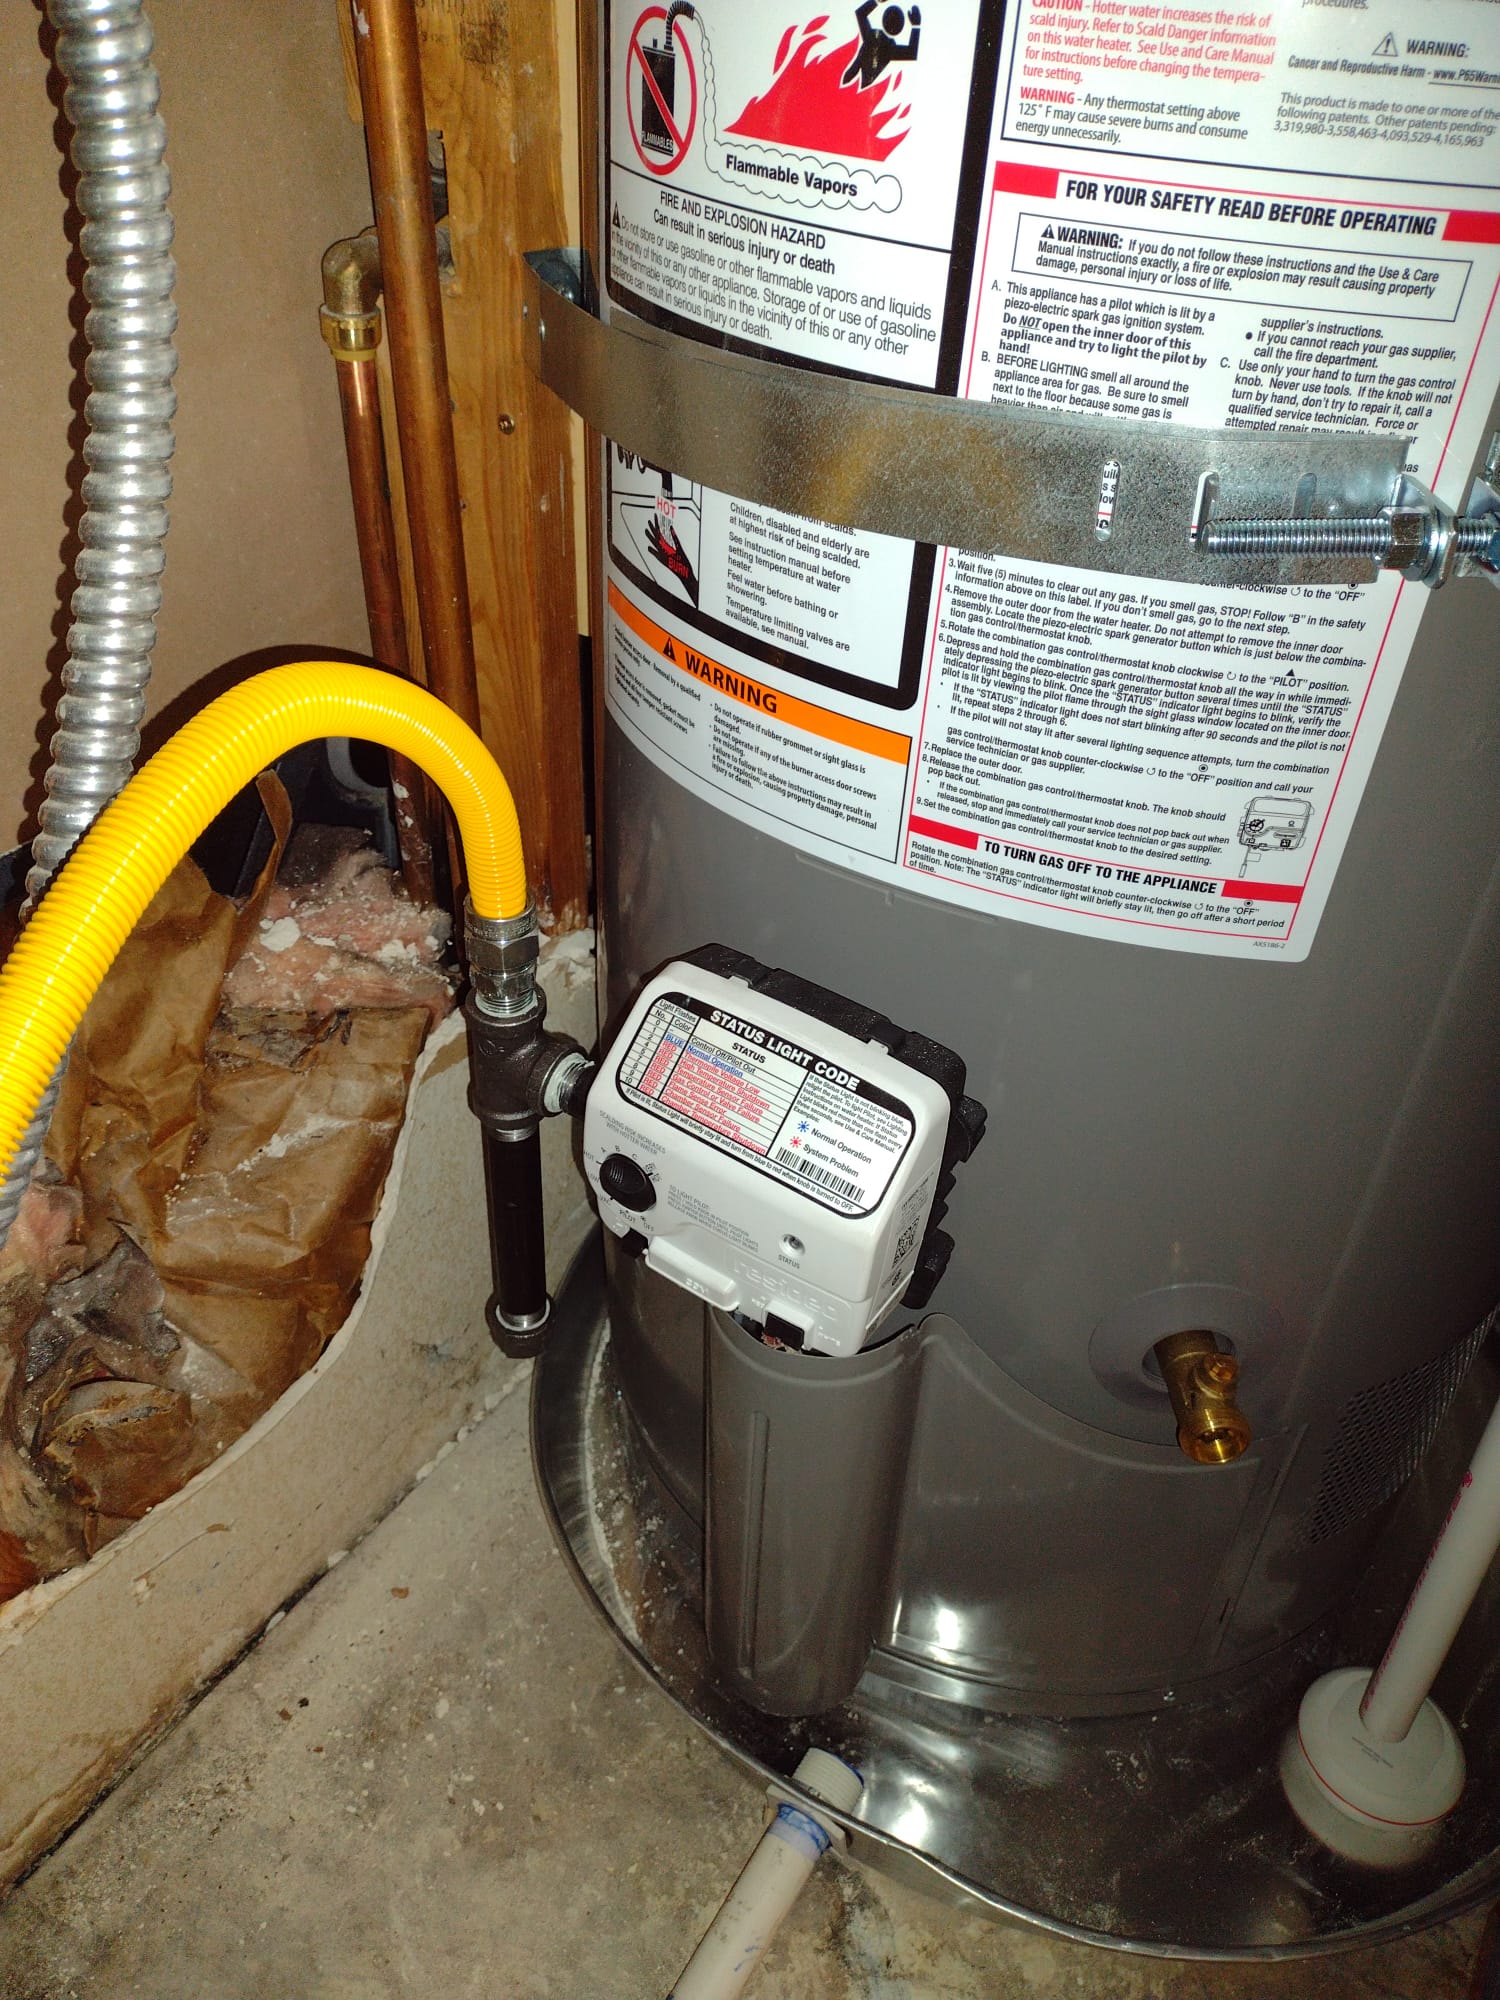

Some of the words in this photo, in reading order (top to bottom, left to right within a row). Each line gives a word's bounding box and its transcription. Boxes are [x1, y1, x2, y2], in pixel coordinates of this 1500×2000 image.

[1406, 39, 1470, 58] WARNING:
[1019, 86, 1075, 103] WARNING
[1083, 92, 1105, 110] Any
[1105, 95, 1166, 113] thermostat
[1166, 102, 1205, 120] setting
[1205, 105, 1241, 121] above
[1015, 120, 1050, 136] energy
[1051, 123, 1120, 145] unnecessarily.
[726, 154, 799, 184] Flammable
[804, 173, 857, 196] Vapors
[1065, 180, 1098, 200] FOR
[1102, 184, 1147, 206] YOUR
[1149, 190, 1214, 214] SAFETY
[1217, 198, 1265, 220] READ
[1267, 203, 1336, 227] BEFORE
[1338, 210, 1438, 235] OPERATING
[660, 191, 680, 210] FIRE
[680, 198, 702, 217] AND
[703, 205, 767, 235] EXPLOSION
[770, 223, 825, 249] HAZARD
[652, 207, 669, 226] Can
[670, 217, 694, 235] result
[696, 223, 705, 238] in
[707, 229, 745, 250] serious
[747, 238, 780, 263] injury
[783, 251, 796, 264] or
[799, 252, 835, 274] death
[1056, 226, 1123, 249] WARNING:
[1128, 238, 1136, 251] If
[1137, 242, 1158, 254] you
[1160, 243, 1174, 255] do
[1177, 246, 1195, 258] not
[1197, 247, 1231, 262] follow
[1232, 251, 1263, 266] these
[1265, 255, 1332, 273] instructions
[1333, 263, 1356, 275] and
[1357, 264, 1376, 277] the
[1377, 266, 1400, 279] Use
[1401, 268, 1411, 280] &
[1412, 269, 1439, 282] Care
[1035, 254, 1077, 272] damage,
[1080, 262, 1126, 277] personal
[1127, 267, 1158, 284] injury
[1159, 274, 1172, 284] or
[1173, 274, 1197, 287] loss
[1198, 277, 1211, 289] of
[1212, 278, 1231, 291] life.
[1002, 312, 1017, 324] Do
[1018, 314, 1042, 327] NOT
[1041, 320, 1069, 332] open
[1071, 322, 1091, 335] the
[1093, 325, 1124, 340] inner
[1125, 330, 1153, 345] door
[1154, 336, 1167, 347] of
[1168, 337, 1191, 350] this
[1260, 318, 1314, 332] supplier's
[1316, 321, 1383, 338] instructions.
[998, 339, 1030, 354] hand!
[1253, 346, 1273, 358] call
[1274, 347, 1293, 360] the
[1294, 350, 1313, 363] fire
[1314, 352, 1378, 368] department.
[1219, 356, 1230, 368] C.
[1238, 359, 1259, 372] Use
[1260, 363, 1284, 377] only
[1284, 366, 1310, 378] your
[1311, 367, 1339, 380] hand
[1340, 369, 1352, 381] to
[1353, 371, 1376, 384] turn
[1377, 373, 1395, 385] the
[1395, 377, 1417, 388] gas
[1417, 378, 1456, 390] control
[657, 496, 676, 518] HOT
[730, 502, 764, 525] Children,
[766, 516, 801, 537] disabled
[803, 530, 819, 542] and
[822, 537, 852, 556] elderly
[853, 548, 869, 559] are
[668, 556, 689, 578] BURN
[728, 555, 752, 573] heater.
[686, 651, 778, 714] WARNING
[924, 739, 931, 750] 7.
[932, 741, 963, 758] Replace
[964, 749, 978, 762] the
[978, 756, 1001, 768] outer
[1002, 760, 1023, 773] door.
[927, 765, 943, 778] pop
[944, 767, 964, 781] back
[964, 774, 980, 785] out.
[918, 860, 936, 873] time.
[983, 839, 1000, 854] TO
[1002, 844, 1036, 862] TURN
[1038, 853, 1064, 868] GAS
[1066, 859, 1092, 874] OFF
[1094, 864, 1112, 878] TO
[1114, 868, 1141, 883] THE
[1142, 872, 1217, 893] APPLIANCE
[655, 1010, 666, 1019] No.
[674, 1020, 692, 1031] Color
[662, 1040, 677, 1052] RED
[665, 1034, 684, 1047] BLUE
[711, 1011, 766, 1044] STATUS
[766, 1038, 813, 1066] LIGHT
[815, 1061, 860, 1091] CODE
[655, 1056, 669, 1067] RED
[658, 1048, 673, 1059] RED
[687, 1045, 711, 1060] Normal
[711, 1057, 743, 1078] Operation
[732, 1043, 766, 1064] STATUS
[647, 1070, 662, 1081] RED
[651, 1063, 665, 1074] RED
[639, 1084, 655, 1096] RED
[643, 1077, 658, 1089] RED
[811, 1128, 837, 1145] Normal
[837, 1141, 872, 1164] Operation
[803, 1143, 829, 1161] System
[830, 1157, 859, 1178] Problem
[778, 1254, 800, 1269] STATUS
